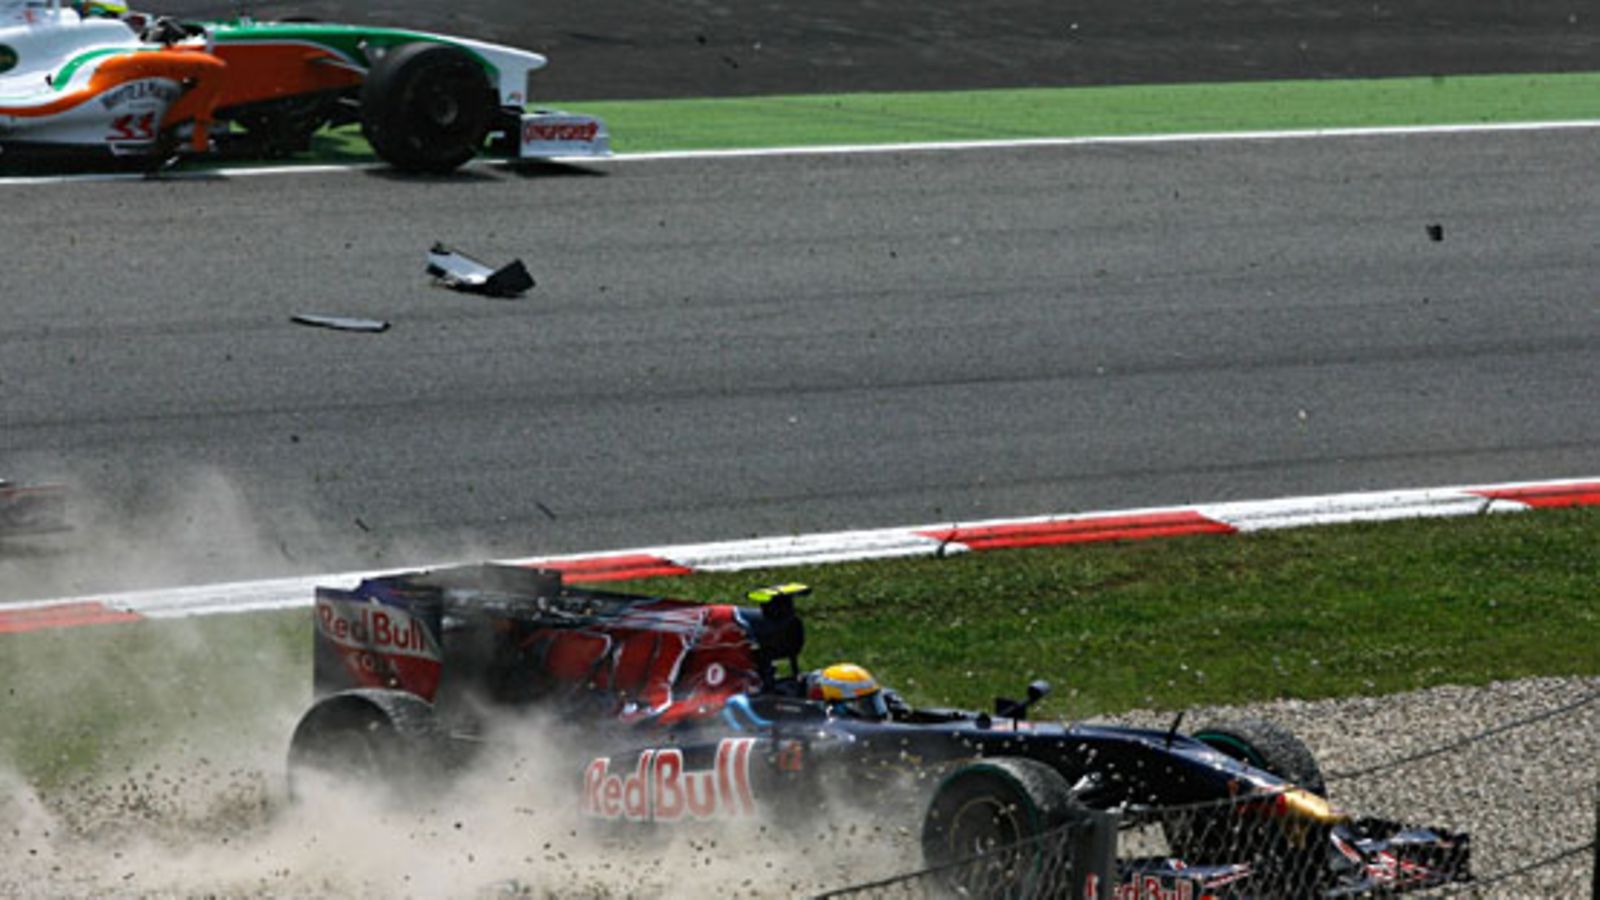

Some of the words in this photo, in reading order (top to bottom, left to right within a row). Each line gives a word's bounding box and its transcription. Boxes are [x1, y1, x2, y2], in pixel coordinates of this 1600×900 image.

[318, 604, 370, 643] Red
[371, 611, 425, 652] Bull
[583, 748, 654, 820] Red
[653, 737, 758, 822] Bull
